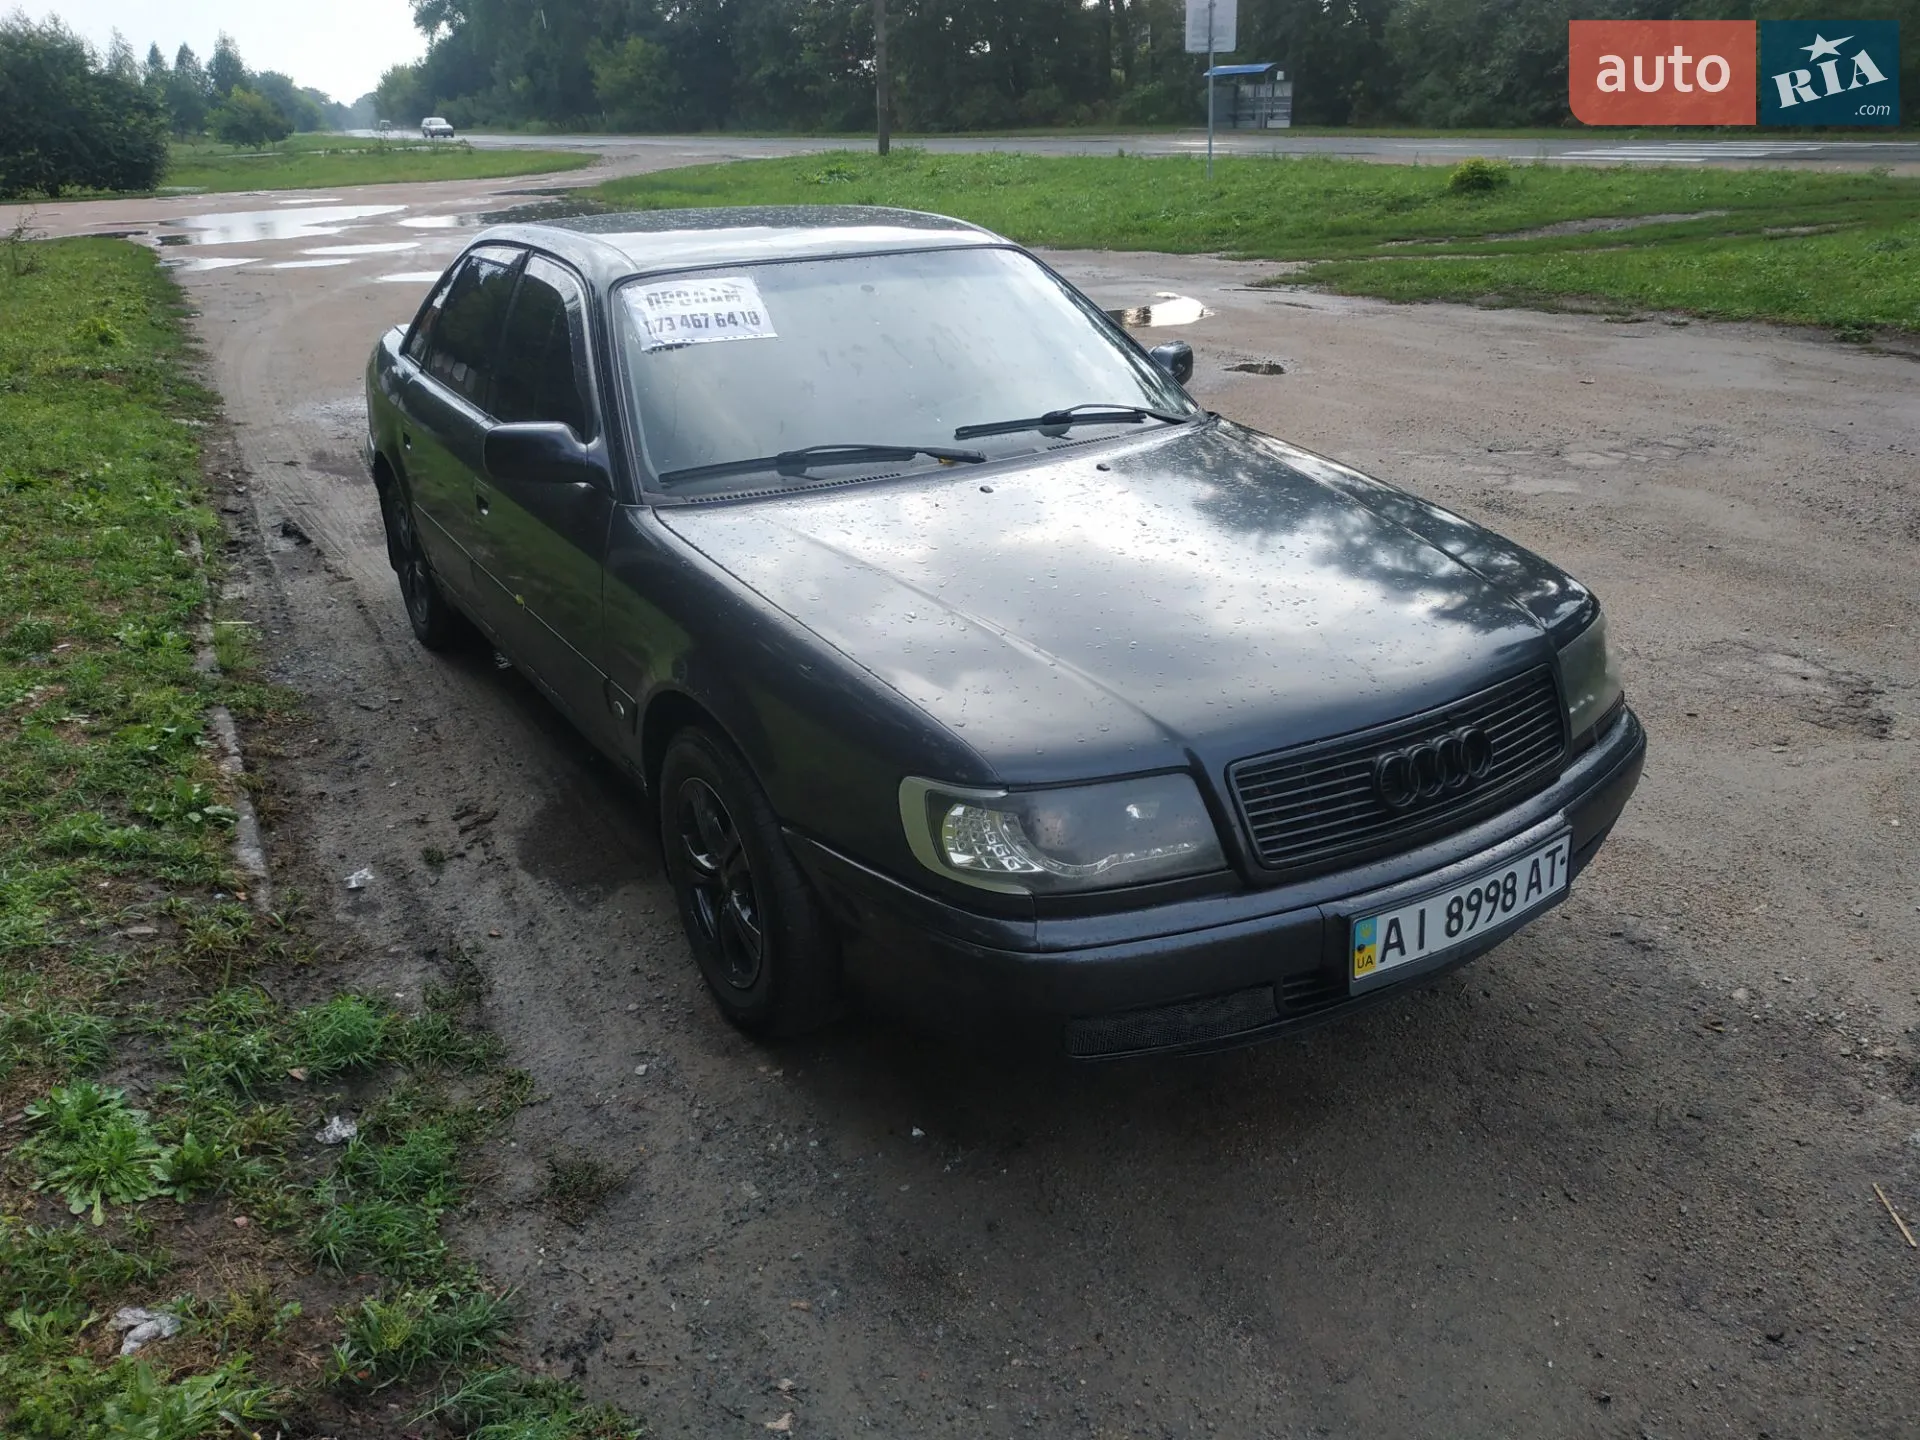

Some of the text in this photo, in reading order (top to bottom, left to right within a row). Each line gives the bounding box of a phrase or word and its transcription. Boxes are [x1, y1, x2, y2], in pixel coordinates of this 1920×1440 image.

[680, 313, 710, 329] 467
[713, 312, 738, 327] 64
[1379, 844, 1563, 963] AI 8998 AT
[1357, 954, 1374, 969] UA
